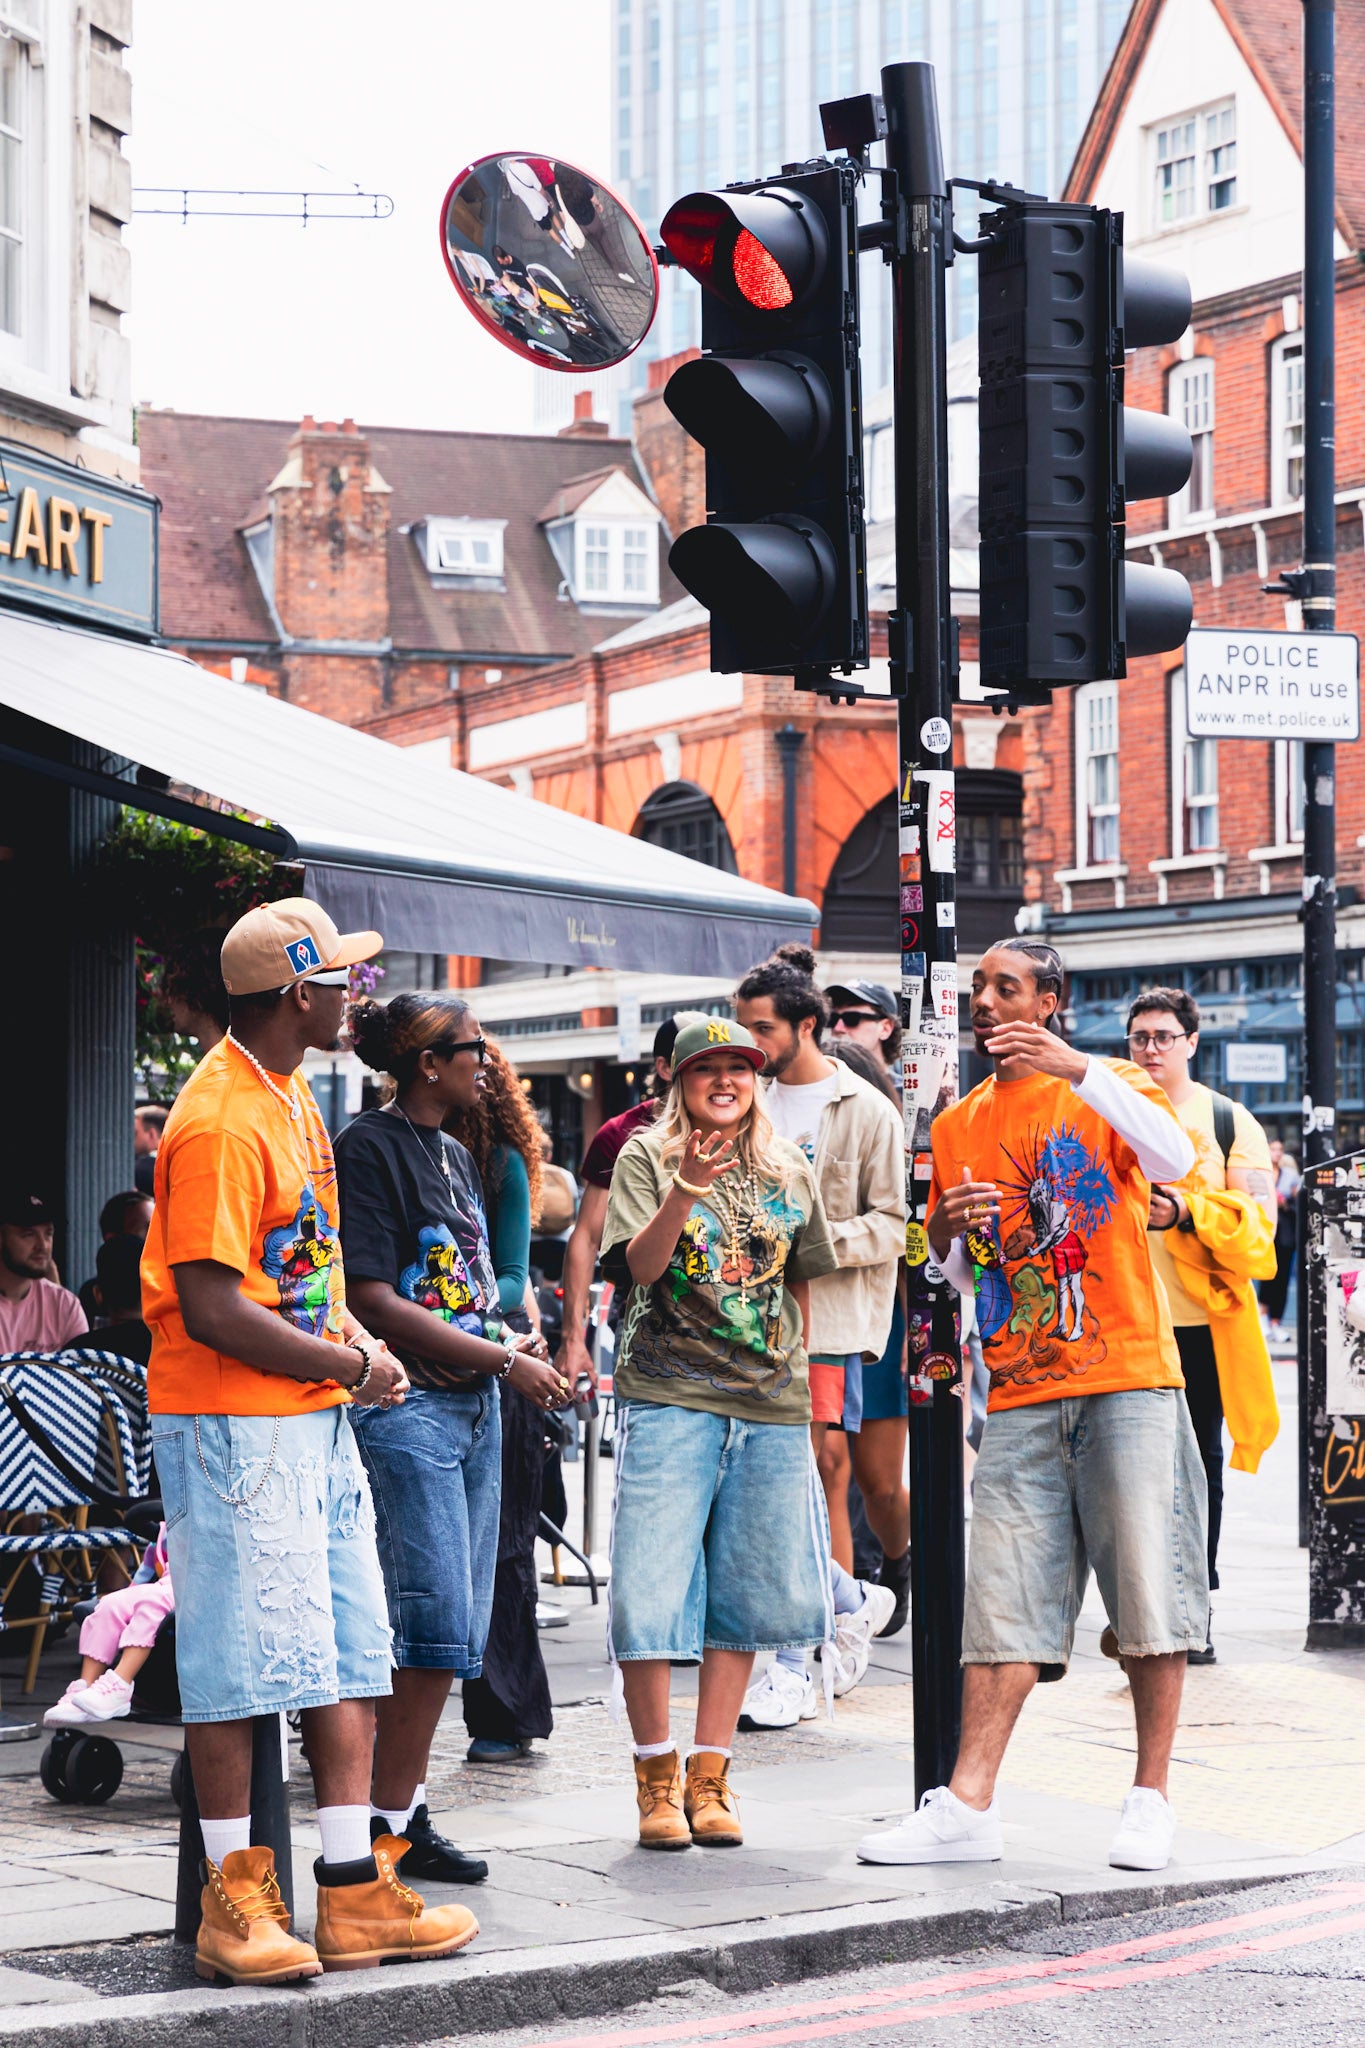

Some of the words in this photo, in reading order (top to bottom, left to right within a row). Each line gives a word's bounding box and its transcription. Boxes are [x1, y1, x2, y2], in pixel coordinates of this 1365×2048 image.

[1226, 644, 1319, 669] POLICE
[1198, 673, 1269, 696] ANPR
[1280, 676, 1299, 697] in
[1310, 682, 1348, 699] use
[1195, 710, 1351, 728] www.met.police.uk
[932, 974, 956, 982] OUTL
[706, 1022, 731, 1043] NY
[908, 1227, 920, 1236] THE
